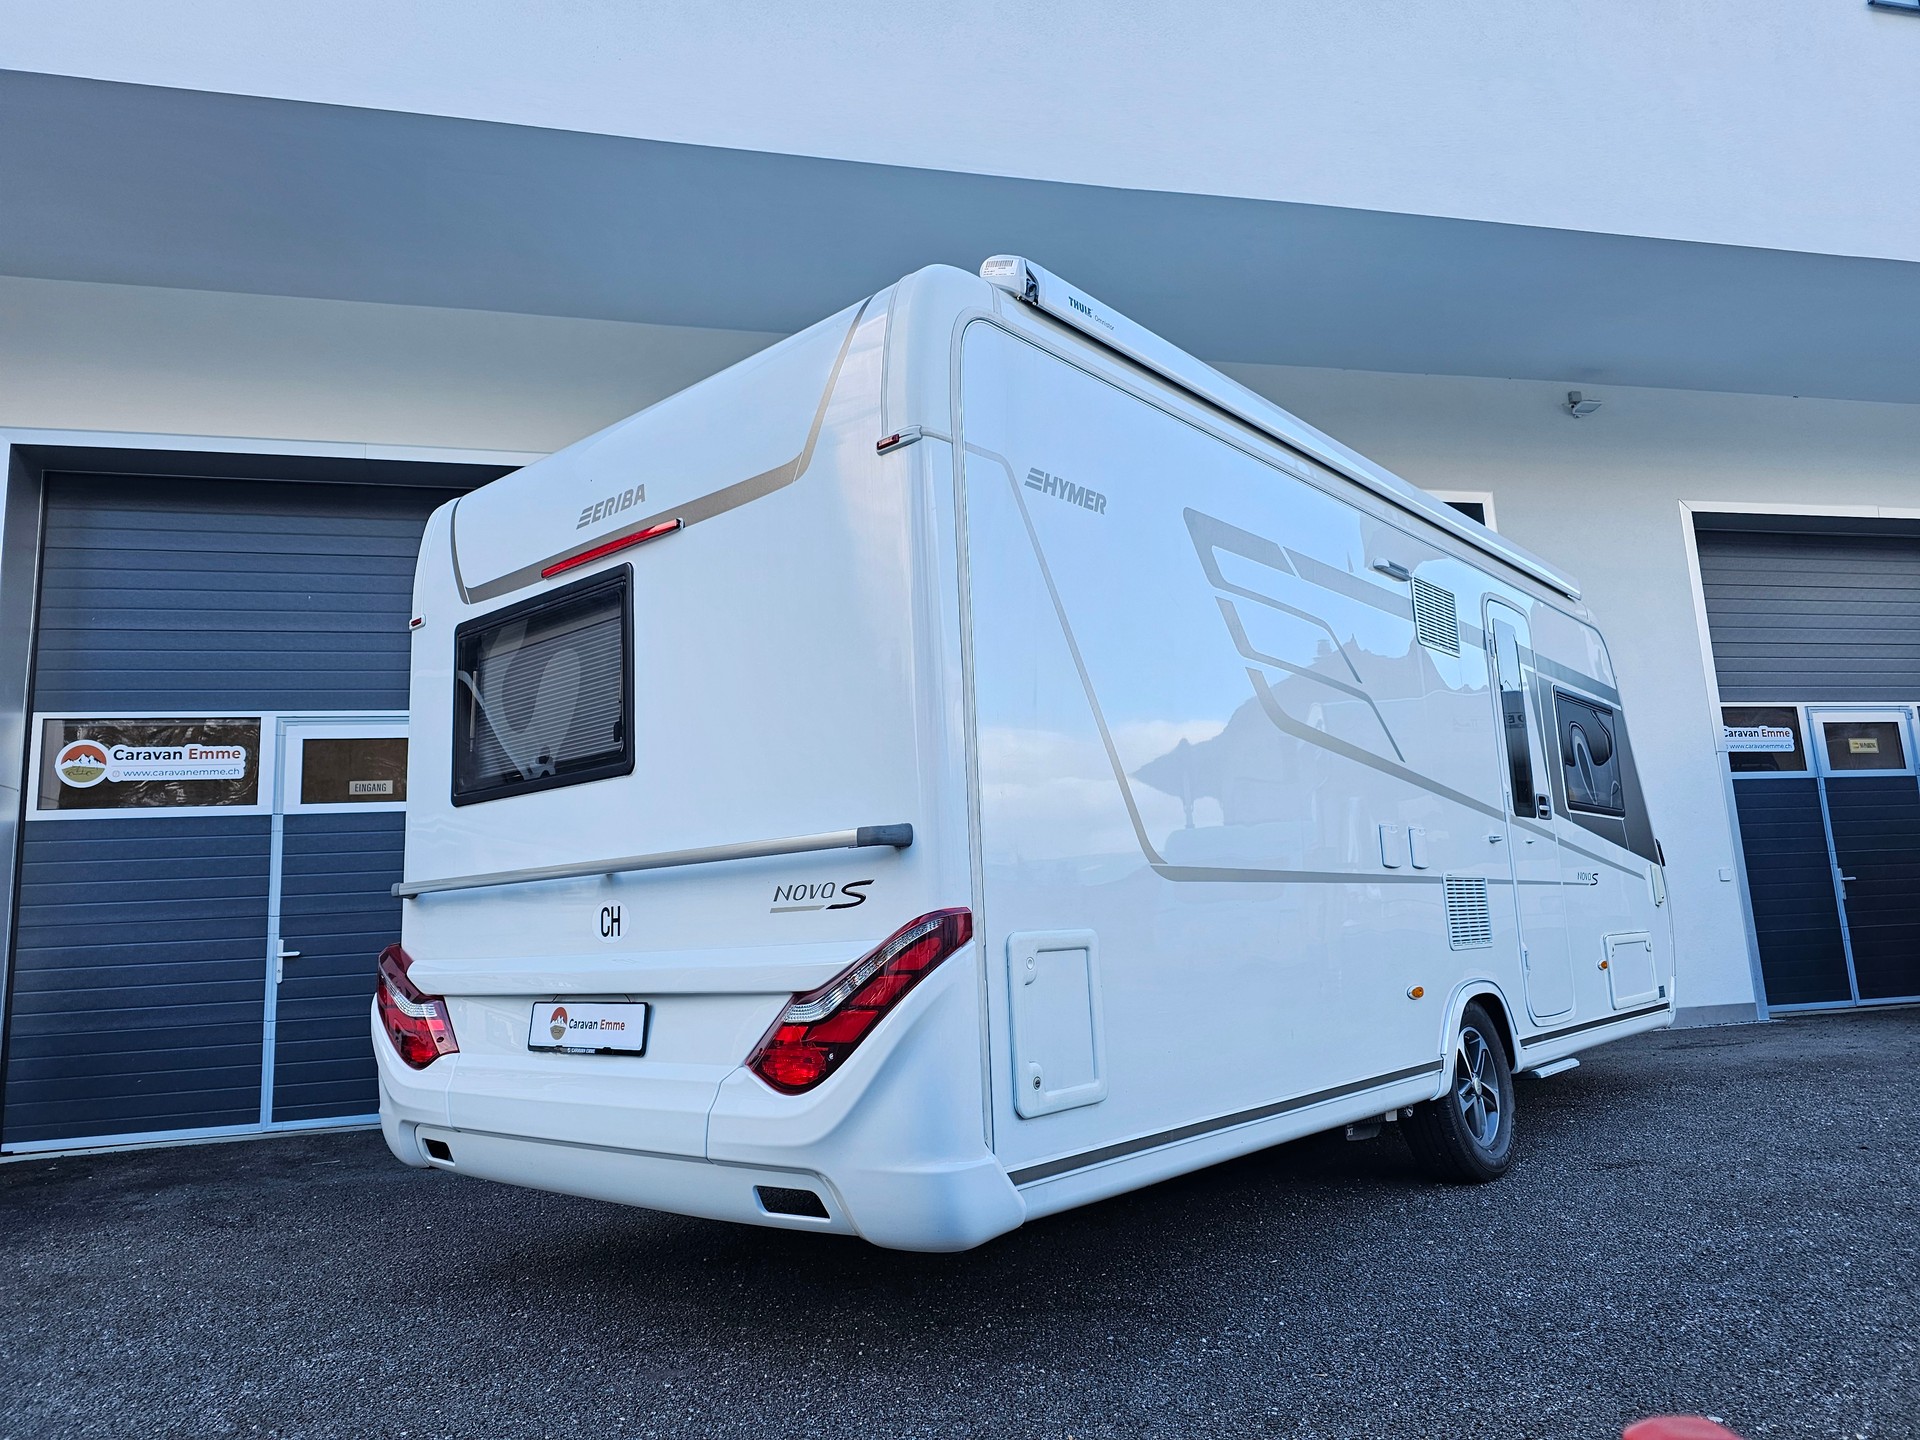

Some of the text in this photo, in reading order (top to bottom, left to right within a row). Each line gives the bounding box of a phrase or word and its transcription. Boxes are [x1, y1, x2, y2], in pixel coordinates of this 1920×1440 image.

[1068, 296, 1092, 318] THULE
[1042, 472, 1107, 515] HYMER
[591, 483, 646, 523] ERIBA
[1761, 728, 1791, 738] Emme
[113, 748, 241, 761] Caravan Emme
[123, 767, 240, 777] www.caravanemme.ch
[354, 783, 387, 793] EINGANG
[825, 879, 875, 910] S
[600, 905, 621, 938] CH
[568, 1018, 626, 1031] Caravan Emme
